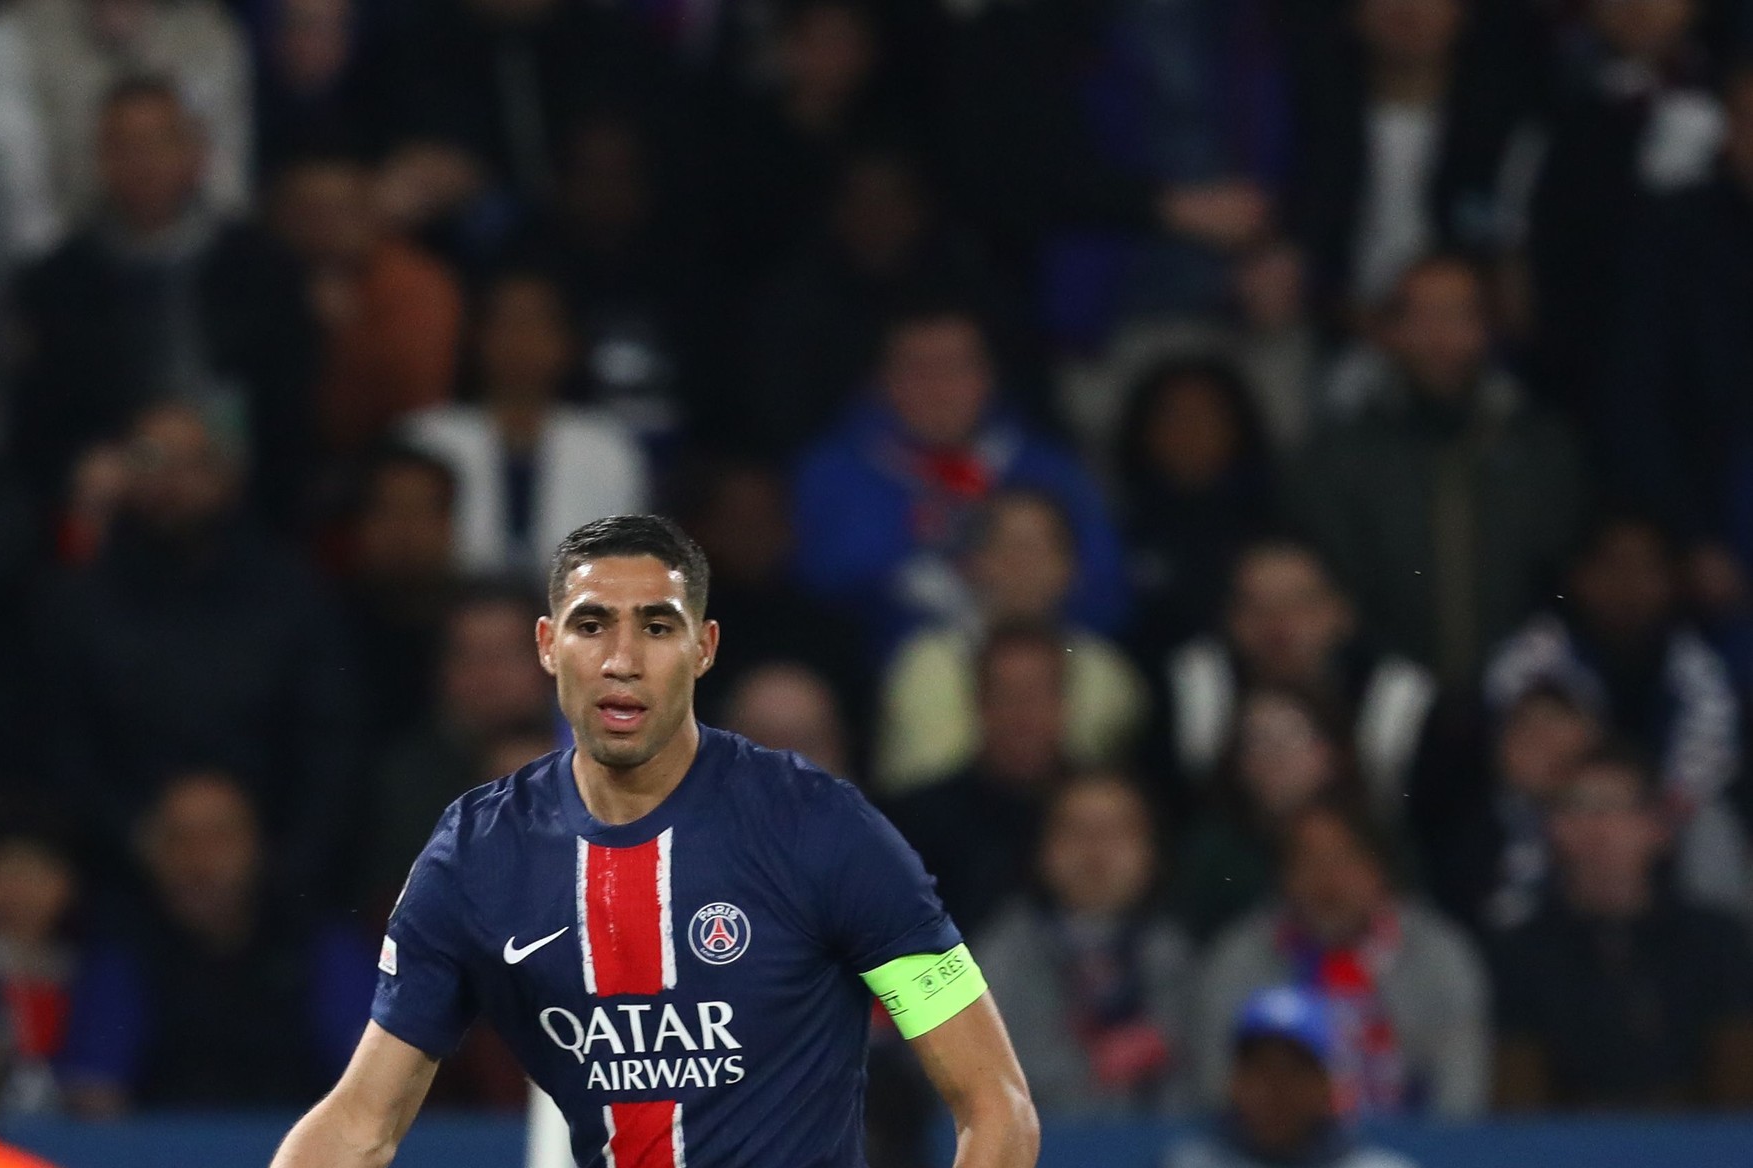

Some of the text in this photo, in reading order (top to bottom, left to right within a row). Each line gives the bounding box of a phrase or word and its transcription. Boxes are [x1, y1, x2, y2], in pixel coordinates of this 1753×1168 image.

[698, 905, 740, 921] PARIS
[539, 1001, 743, 1064] QATAR
[587, 1055, 745, 1091] AIRWAYS
